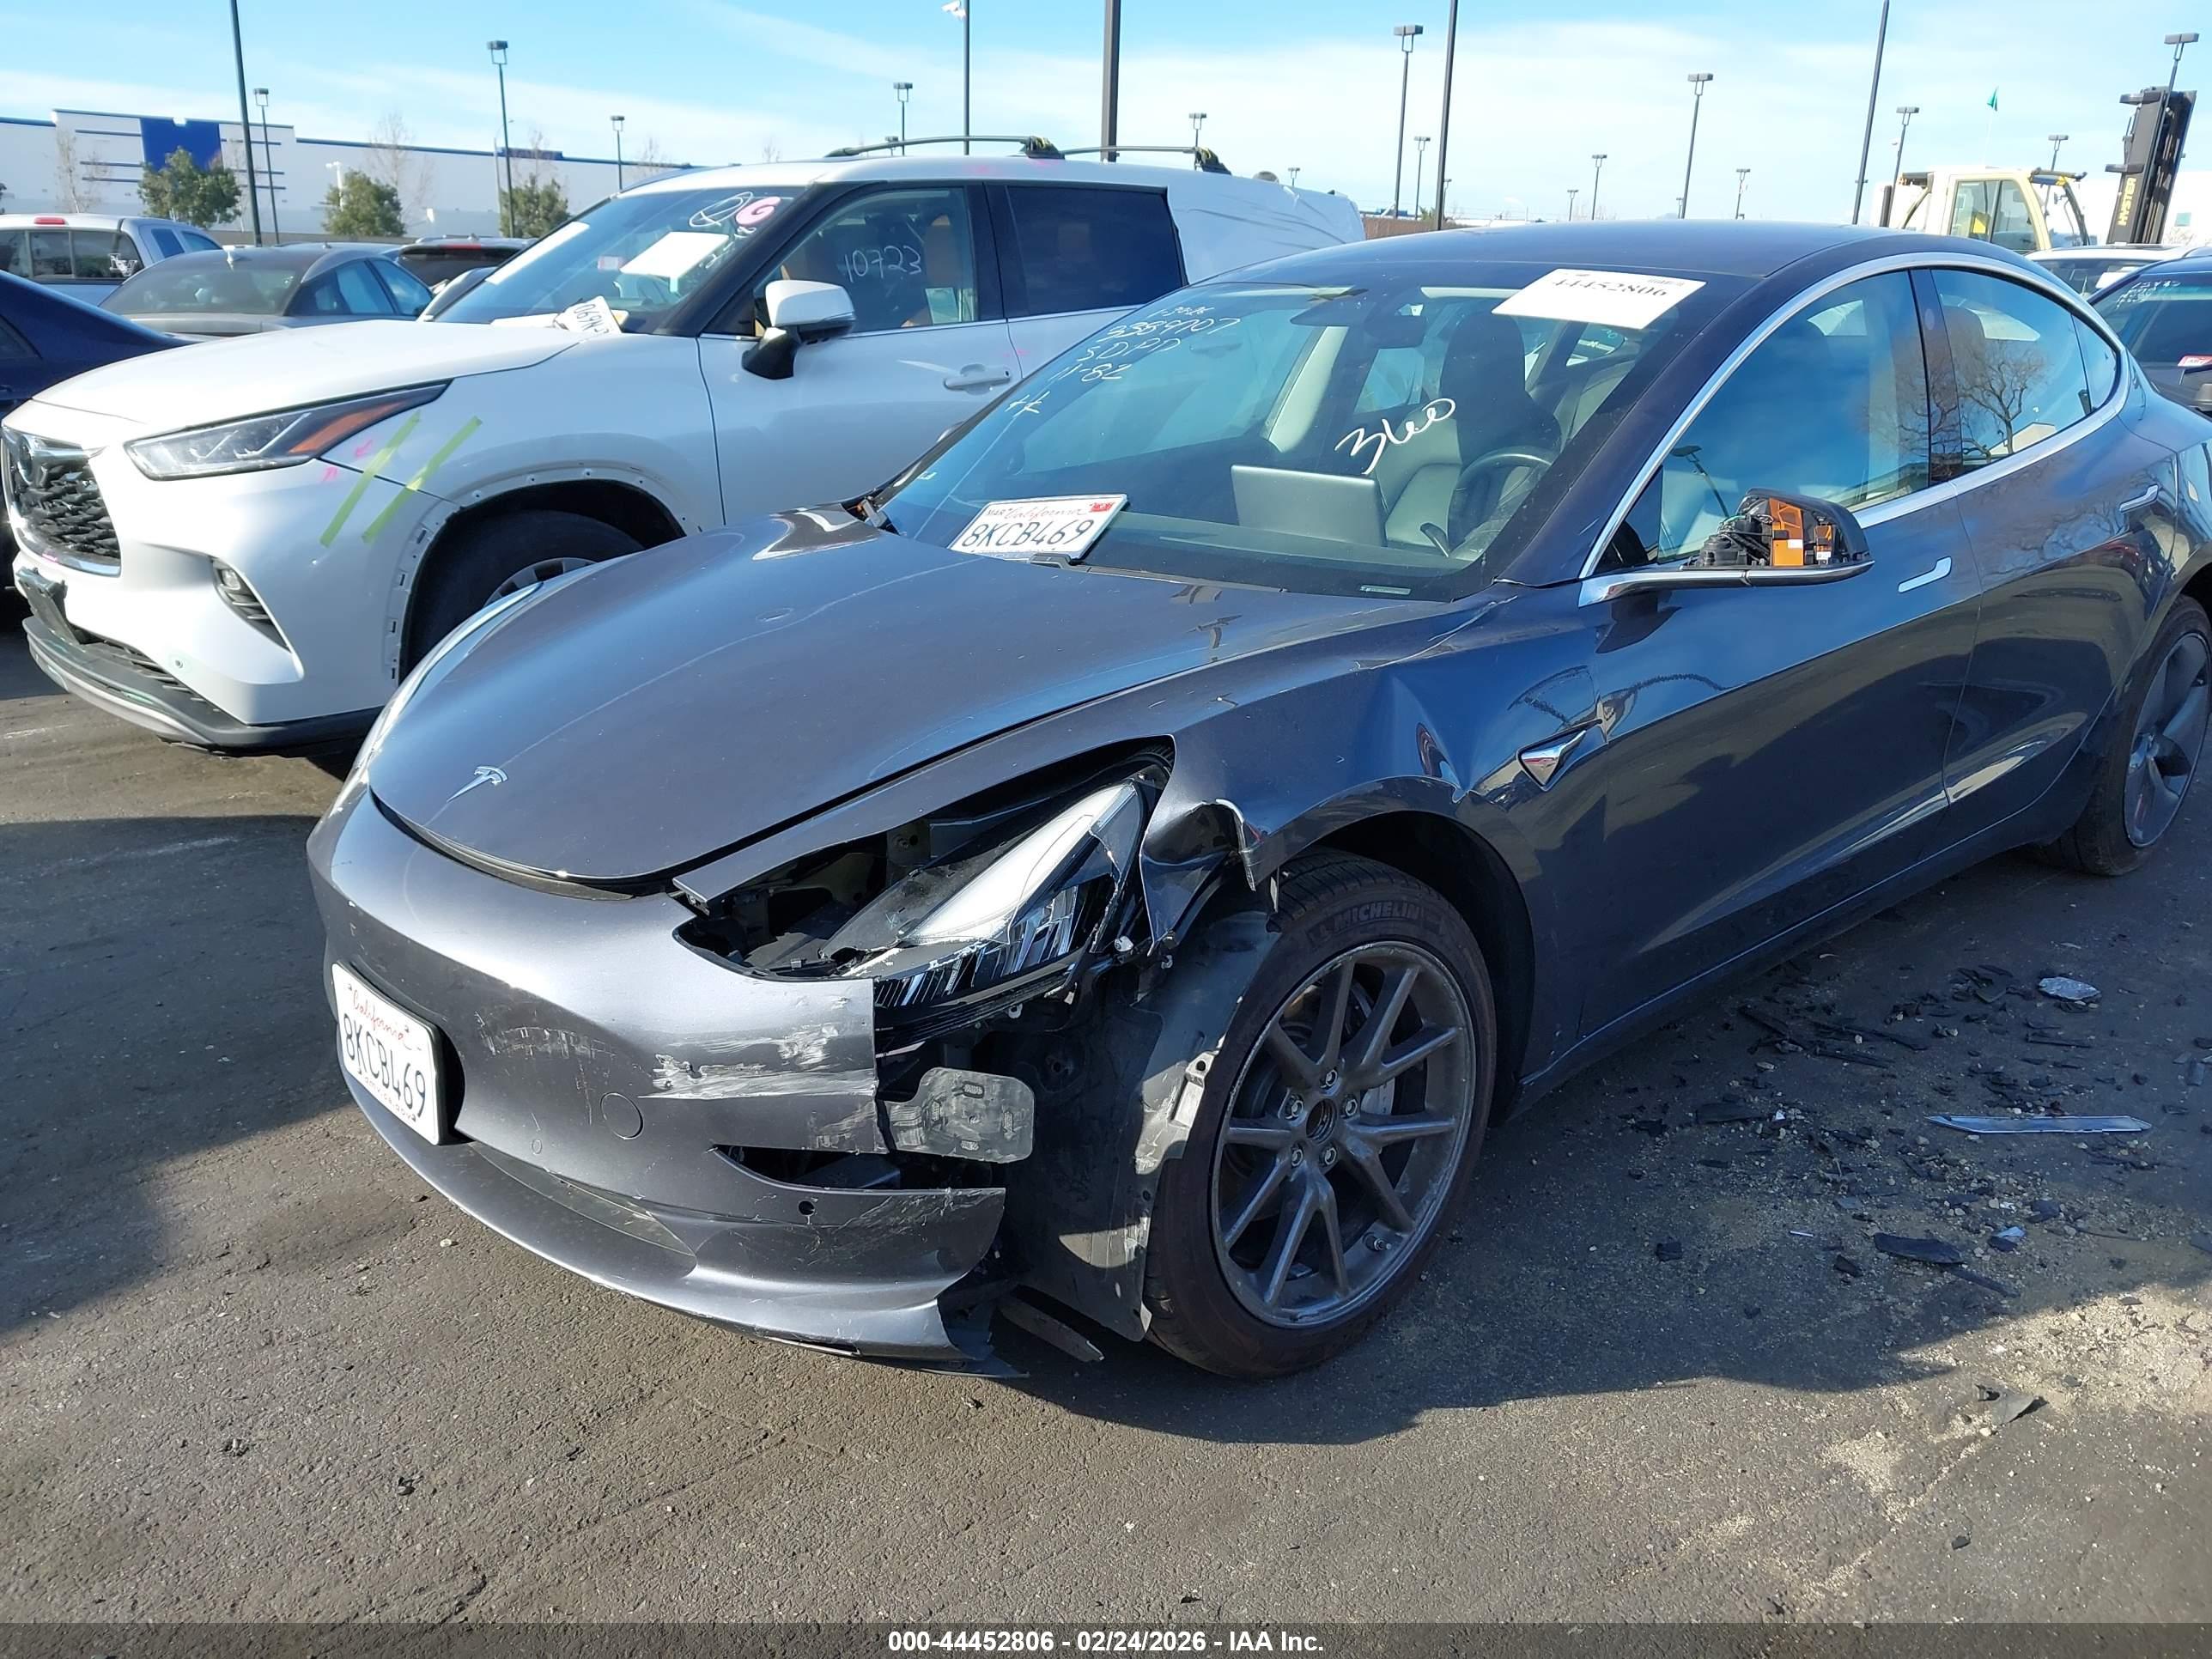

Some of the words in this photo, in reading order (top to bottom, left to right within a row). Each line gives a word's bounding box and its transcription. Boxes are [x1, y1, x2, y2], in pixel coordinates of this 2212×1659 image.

[2118, 177, 2137, 226] HYSTER
[844, 245, 922, 283] 10723
[1552, 278, 1668, 296] 44452806
[1004, 505, 1088, 522] California
[961, 519, 1095, 548] 8KCB469
[1331, 901, 1424, 932] MICHELIN
[352, 988, 410, 1050] California
[344, 1012, 426, 1118] 8KCB469
